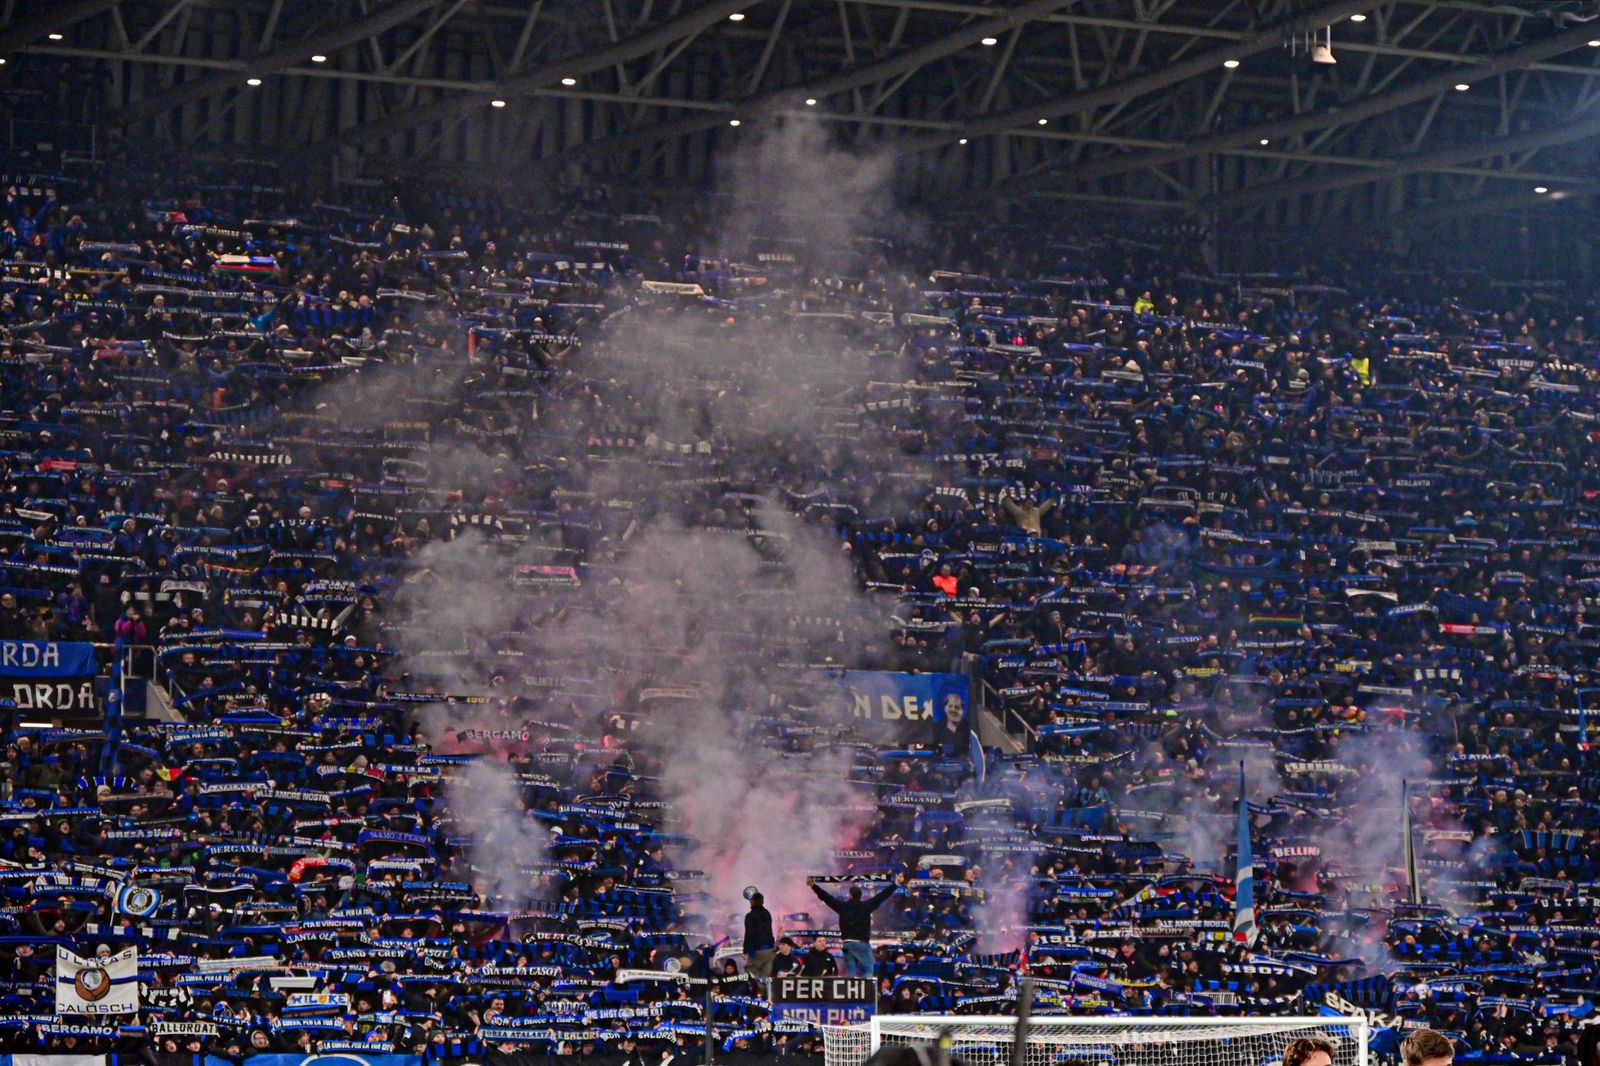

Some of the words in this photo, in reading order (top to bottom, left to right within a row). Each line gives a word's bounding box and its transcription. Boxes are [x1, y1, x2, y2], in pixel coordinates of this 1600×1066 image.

[1396, 479, 1431, 488] ATALANTA
[2, 642, 59, 668] RDA
[465, 729, 529, 741] BERGAMO
[210, 844, 264, 855] BERGAMO
[824, 875, 888, 883] IVAN
[321, 920, 342, 928] VINCI
[343, 920, 356, 928] PER
[332, 950, 366, 960] ISLAND
[378, 950, 405, 959] CREW
[782, 979, 824, 999] PER
[832, 979, 866, 999] CHI
[43, 1024, 113, 1036] BERGAMO
[773, 1025, 809, 1034] ATALANTA
